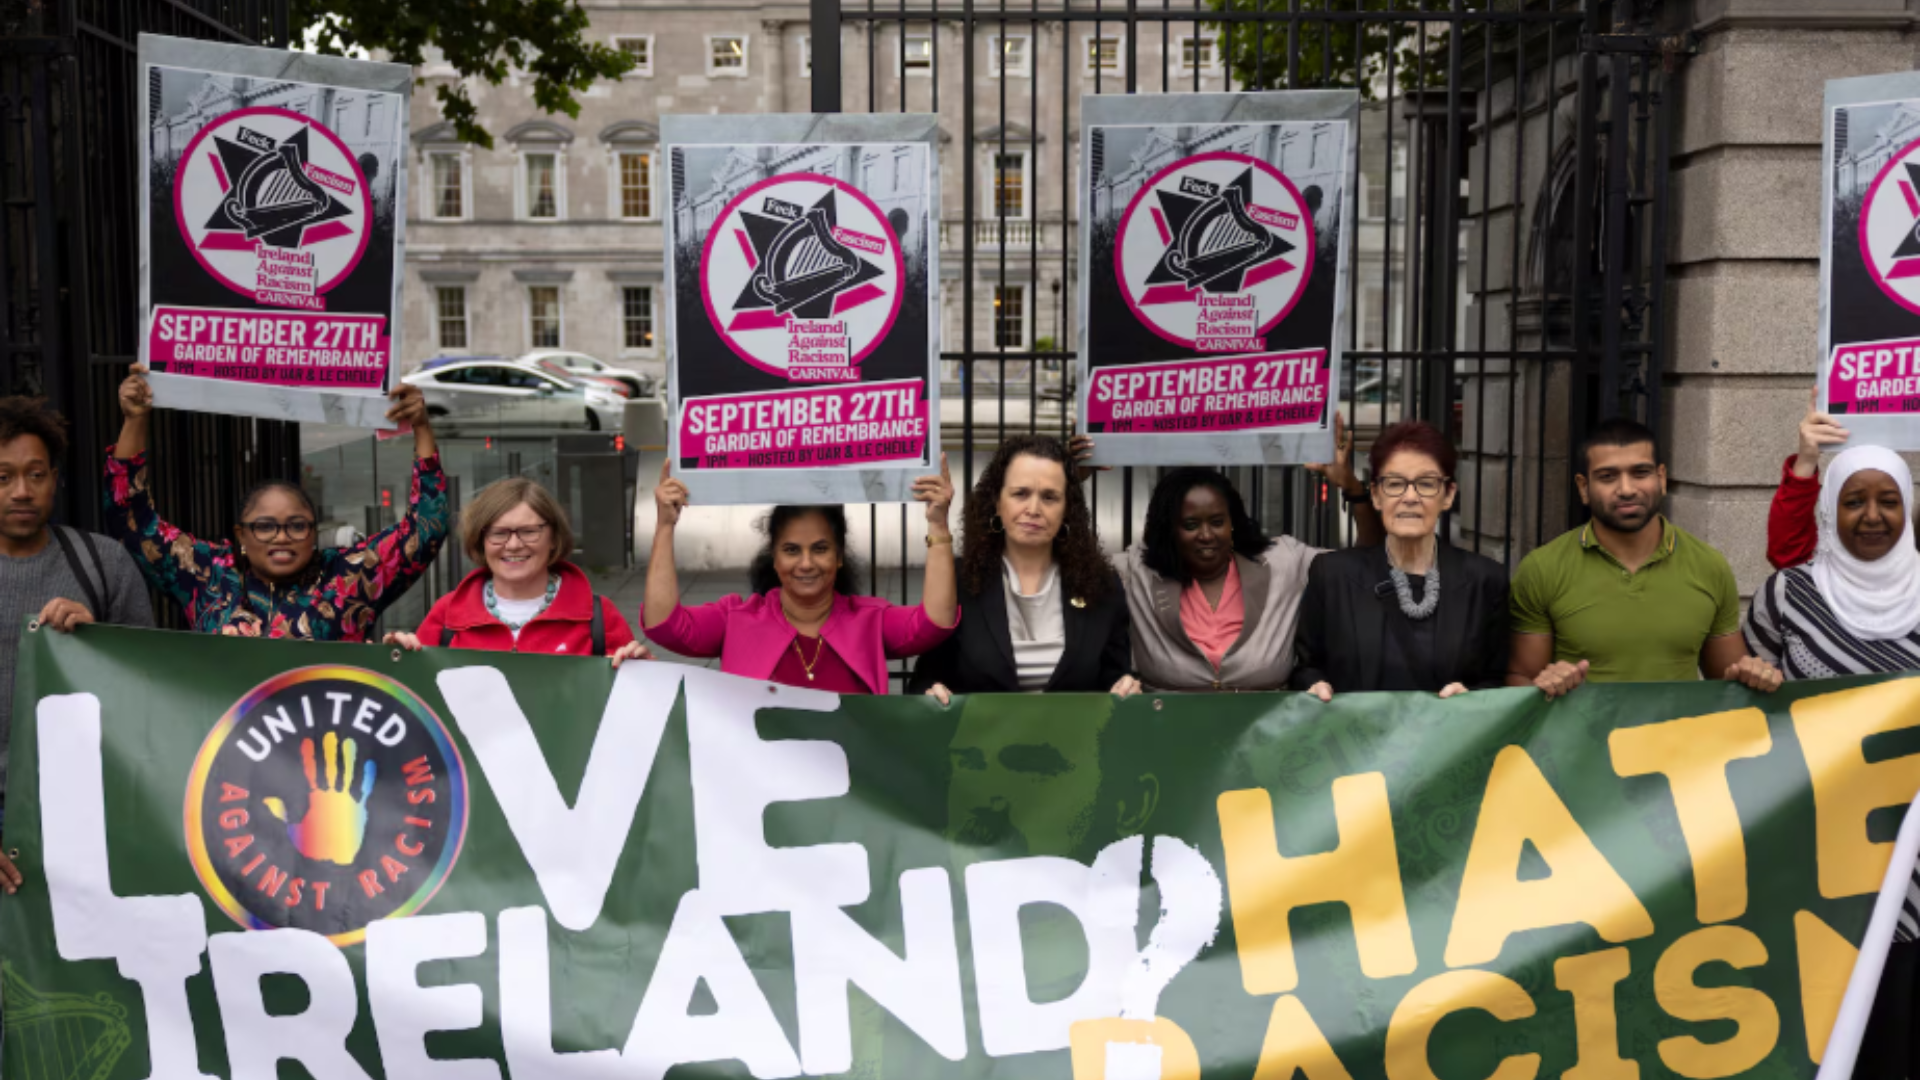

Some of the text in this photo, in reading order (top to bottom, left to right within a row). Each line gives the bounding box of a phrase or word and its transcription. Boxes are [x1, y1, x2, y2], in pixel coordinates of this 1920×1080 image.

[240, 128, 271, 149] Feck
[303, 165, 353, 193] Fascism
[1183, 177, 1215, 196] Feck
[767, 199, 798, 218] Feck
[1248, 205, 1296, 228] Fascism
[833, 228, 883, 251] Fascism
[257, 248, 311, 265] Ireland
[256, 260, 313, 278] Against
[256, 273, 312, 292] Racism
[255, 290, 324, 309] CARNIVAL
[1197, 293, 1252, 307] Ireland
[1196, 307, 1254, 323] Against
[159, 313, 378, 349] SEPTEMBER 27TH
[788, 320, 843, 334] Ireland
[1196, 322, 1252, 336] Racism
[788, 334, 846, 350] Against
[1195, 337, 1264, 351] CARNIVAL
[174, 342, 385, 369] GARDEN OF REMEMBRANCE
[788, 350, 845, 363] Racism
[173, 361, 195, 375] 1PM
[213, 364, 259, 380] HOSTED
[261, 365, 276, 380] BY
[306, 368, 315, 381] &
[319, 368, 332, 382] LE
[788, 367, 858, 379] CARNIVAL
[1096, 357, 1318, 401] SEPTEMBER 27TH
[688, 388, 915, 434] SEPTEMBER 27TH
[1112, 385, 1324, 419] GARDEN OF REMEMBRANCE
[1855, 399, 1879, 413] 1PM
[1112, 419, 1133, 432] 1PM
[1153, 415, 1199, 431] HOSTED
[1201, 413, 1216, 428] BY
[1245, 410, 1254, 424] &
[1258, 409, 1272, 423] LE
[705, 417, 923, 454] GARDEN OF REMEMBRANCE
[705, 454, 728, 468] 1PM
[748, 449, 796, 466] HOSTED
[798, 447, 814, 463] BY
[817, 445, 841, 461] UAR
[844, 444, 853, 458] &
[857, 442, 872, 457] LE
[236, 691, 407, 762] UNITED
[218, 754, 436, 911] AGAINST RACISM
[1217, 676, 1920, 995] HATE
